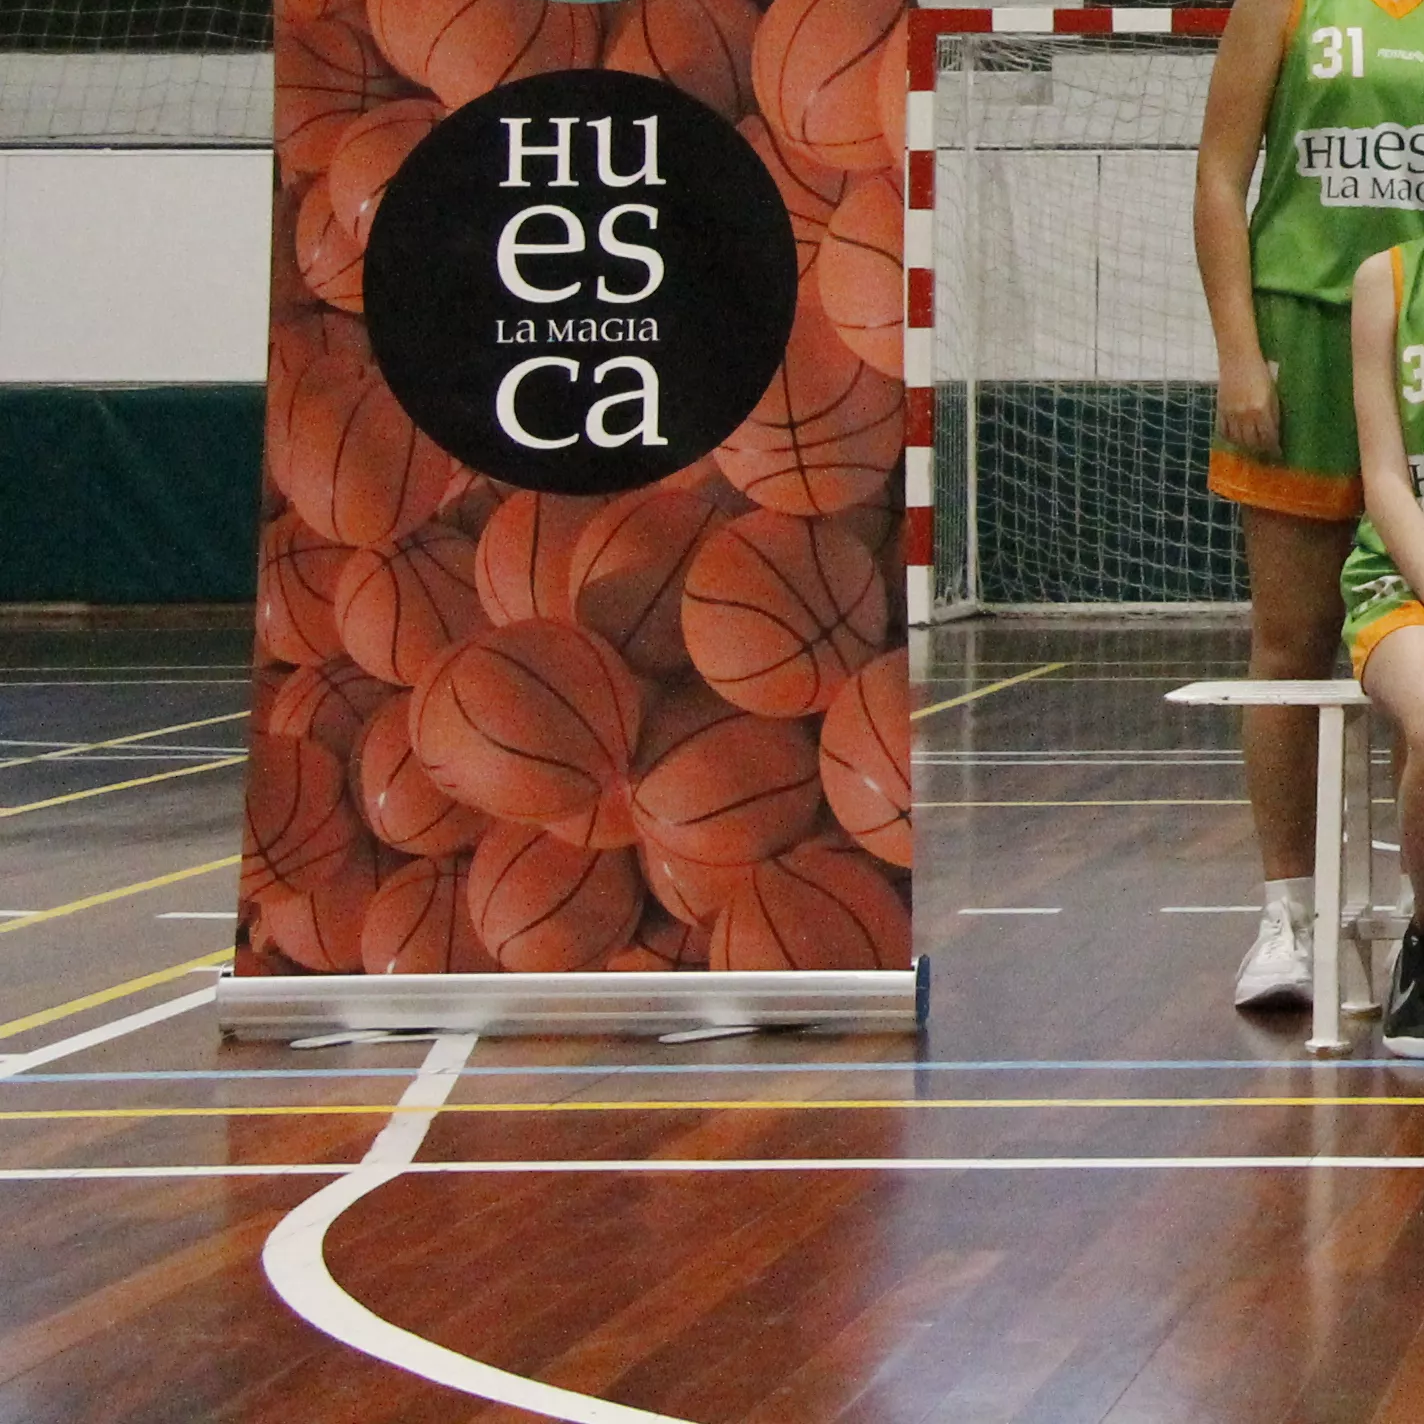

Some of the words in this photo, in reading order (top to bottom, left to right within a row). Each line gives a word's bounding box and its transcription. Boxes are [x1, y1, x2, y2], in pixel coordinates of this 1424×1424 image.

[1312, 26, 1365, 79] 31
[496, 203, 665, 304] es
[495, 318, 537, 344] La
[495, 355, 668, 450] ca
